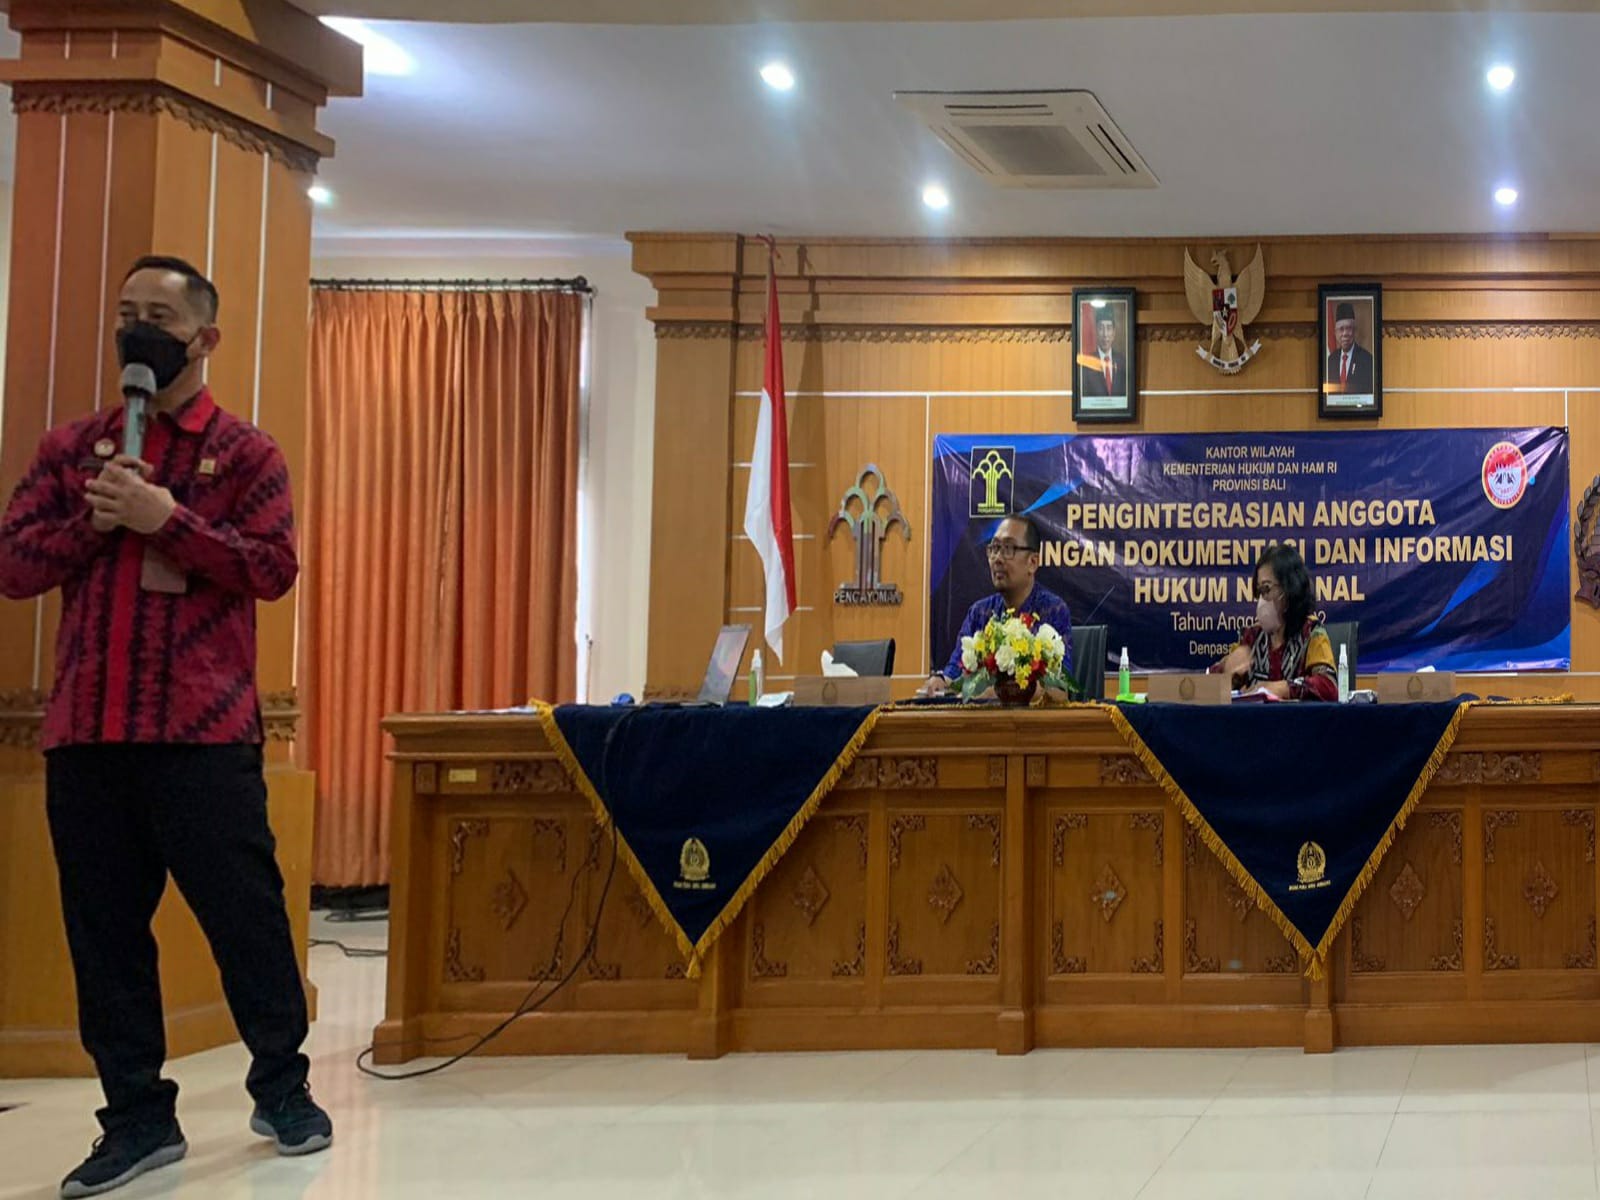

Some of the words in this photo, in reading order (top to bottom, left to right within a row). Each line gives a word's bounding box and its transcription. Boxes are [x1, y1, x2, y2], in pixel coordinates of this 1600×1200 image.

[1206, 446, 1248, 459] KANTOR
[1250, 446, 1295, 458] WILAYAH
[1163, 463, 1235, 475] KEMENTERIAN
[1238, 463, 1275, 475] HUKUM
[1278, 462, 1299, 474] DAN
[1302, 462, 1325, 474] HAM
[1327, 461, 1337, 473] RI
[1213, 479, 1260, 491] PROVINSI
[1262, 478, 1286, 490] BALI
[1067, 502, 1304, 529] PENGINTEGRASIAN
[1312, 500, 1436, 527] ANGGOTA
[1039, 540, 1115, 567] INGAN
[1124, 538, 1305, 566] DOKUMENTI
[1315, 537, 1366, 564] DAN
[1375, 535, 1513, 563] INFORMASI
[1134, 577, 1228, 603] HUKUM
[1236, 575, 1365, 602] NNAL
[1170, 611, 1213, 631] Tahun
[1189, 640, 1233, 658] Denpas
